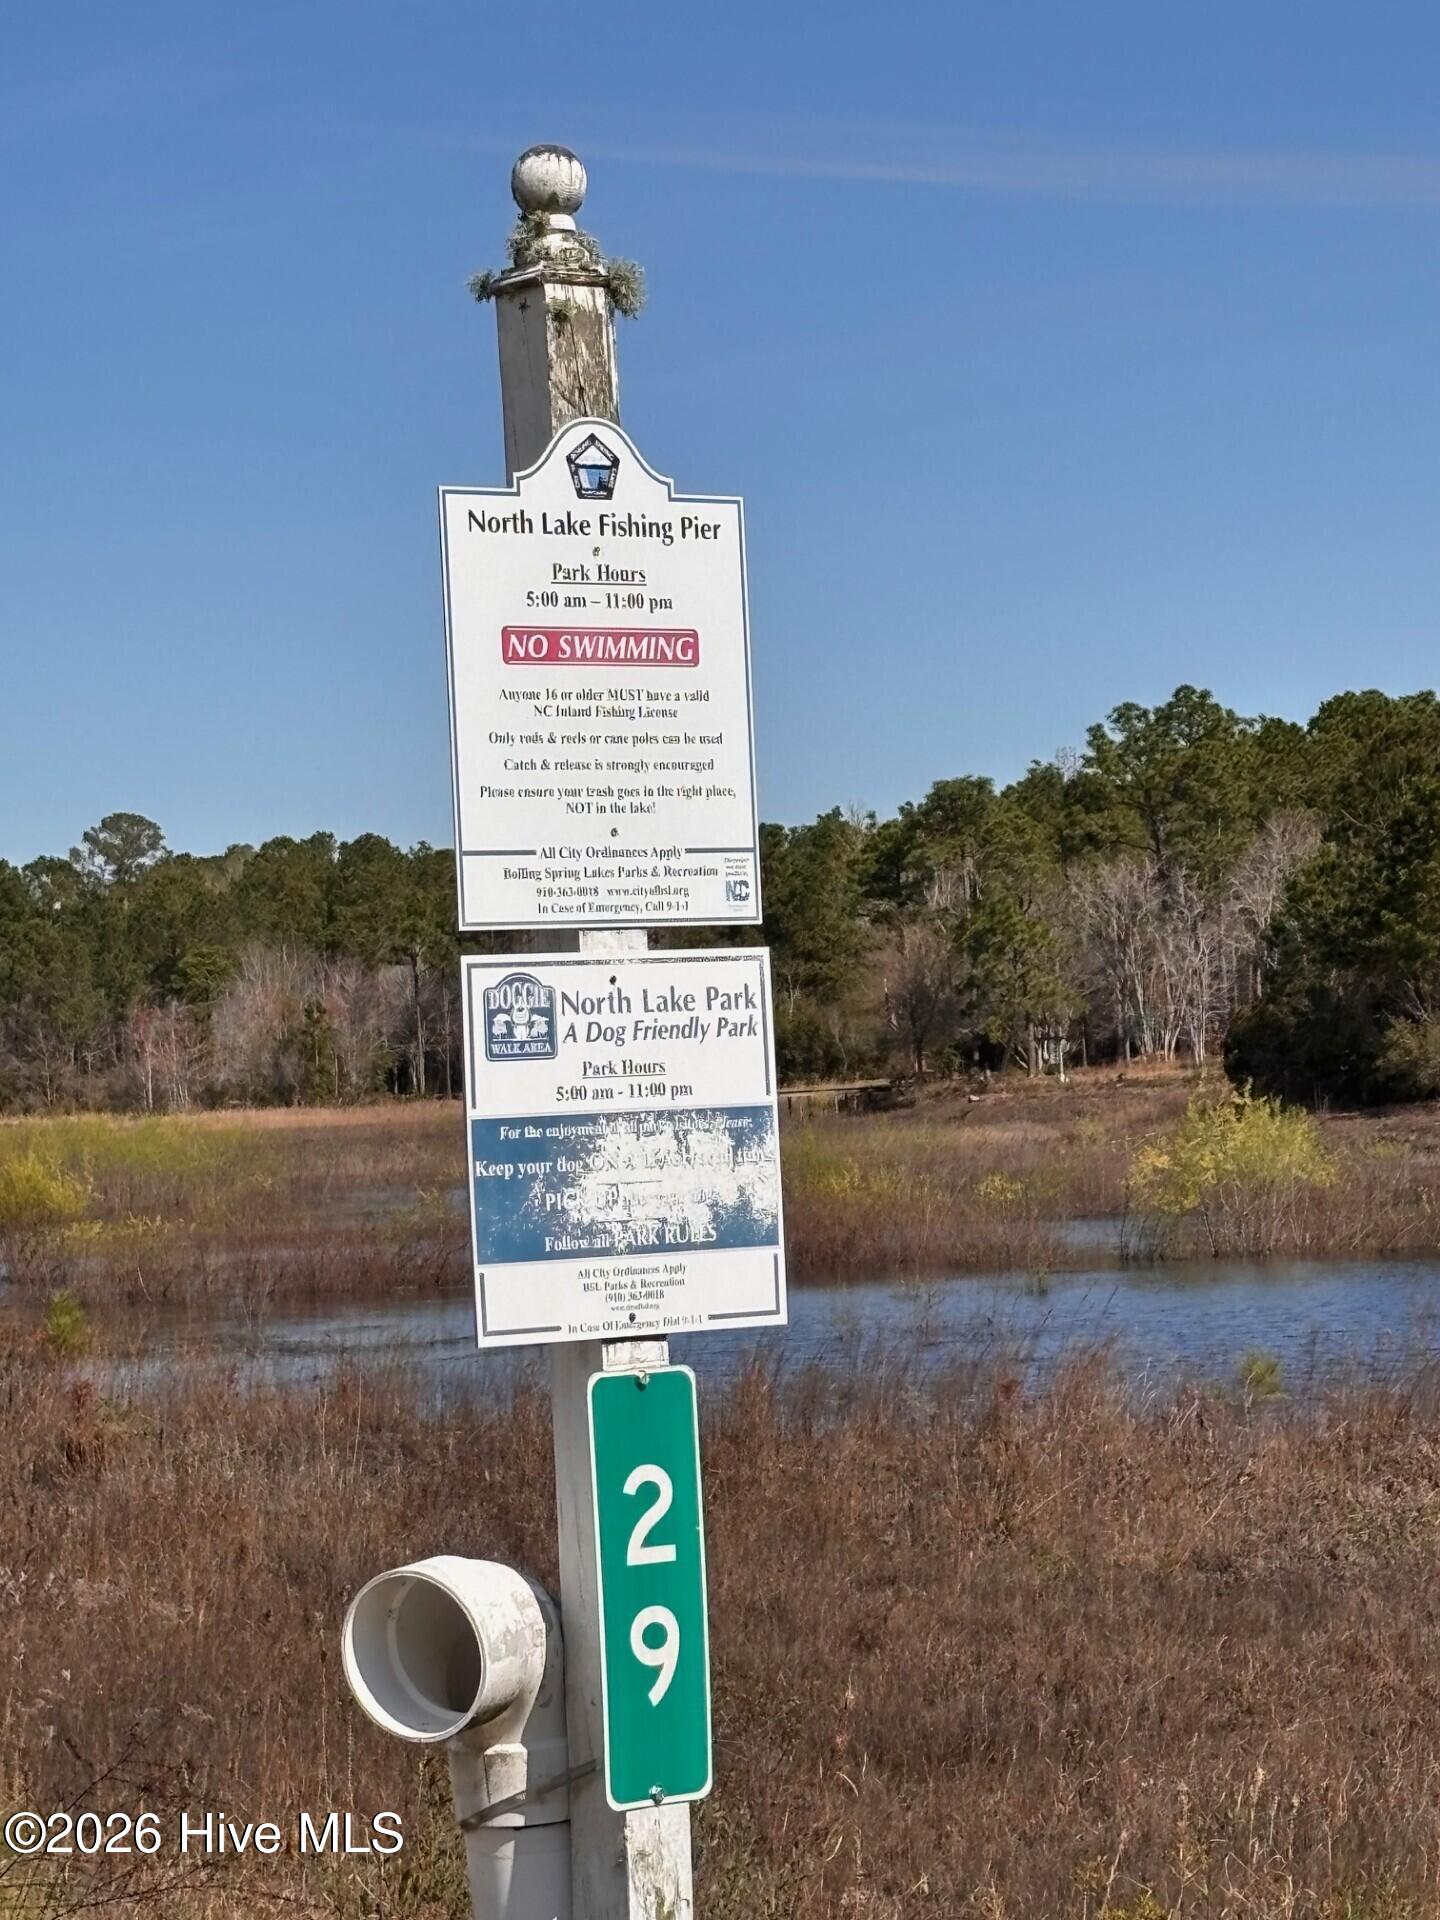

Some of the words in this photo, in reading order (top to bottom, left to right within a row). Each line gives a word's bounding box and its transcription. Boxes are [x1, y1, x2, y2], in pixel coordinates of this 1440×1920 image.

[468, 509, 534, 534] North
[542, 511, 591, 536] Lake
[600, 513, 674, 546] Fishing
[681, 517, 722, 540] Pier
[552, 563, 590, 582] Park
[598, 564, 646, 583] Hours
[526, 591, 558, 608] 5:00
[563, 596, 586, 608] am
[605, 592, 644, 610] 11:00
[650, 597, 672, 614] pm
[507, 634, 548, 658] NO
[558, 634, 694, 660] SWIMMING
[499, 688, 541, 702] Anyone
[546, 688, 558, 700] 16
[561, 692, 573, 700] or
[576, 688, 604, 701] older
[608, 688, 643, 701] MUST
[646, 690, 672, 702] have
[674, 692, 680, 702] a
[684, 690, 710, 702] valid
[534, 705, 552, 717] NC
[556, 705, 592, 717] Inland
[596, 705, 636, 720] Fishing
[638, 706, 678, 718] License
[489, 732, 515, 746] Only
[548, 732, 557, 744] &
[561, 732, 586, 744] reels
[590, 734, 602, 744] or
[604, 734, 629, 744] cane
[632, 732, 659, 748] poles
[662, 735, 680, 744] can
[684, 732, 696, 744] be
[699, 732, 723, 744] used
[504, 758, 537, 771] Catch
[540, 759, 551, 771] &
[554, 759, 592, 771] release
[594, 759, 603, 771] is
[606, 759, 650, 774] strongly
[654, 758, 714, 774] encouraged
[480, 786, 515, 798] Please
[518, 788, 554, 798] ensure
[558, 788, 582, 800] your
[586, 786, 614, 798] trash
[617, 788, 640, 800] goes
[656, 786, 674, 797] the
[677, 786, 702, 799] right
[706, 786, 736, 800] place,
[566, 802, 593, 814] NOT
[596, 802, 606, 814] in
[610, 802, 627, 814] the
[630, 802, 656, 814] lake!
[540, 847, 555, 859] All
[559, 846, 582, 861] City
[586, 846, 648, 858] Ordinances
[650, 846, 682, 860] Apply
[545, 867, 580, 882] Spring
[584, 866, 614, 878] Lakes
[618, 866, 648, 878] Parks
[650, 866, 660, 878] &
[664, 865, 718, 878] Recreation
[538, 903, 548, 914] In
[551, 903, 574, 914] Case
[576, 902, 586, 913] of
[588, 902, 642, 915] Emergency,
[646, 901, 664, 912] Call
[666, 901, 688, 912] 9-1-1
[488, 982, 550, 1010] DOGGIE
[561, 988, 632, 1016] North
[643, 987, 696, 1013] Lake
[706, 984, 758, 1011] Park
[563, 1021, 578, 1044] A
[586, 1020, 627, 1046] Dog
[632, 1016, 710, 1044] Friendly
[716, 1014, 758, 1038] Park
[491, 1043, 521, 1054] WALK
[523, 1042, 552, 1053] AREA
[582, 1060, 618, 1077] Park
[622, 1060, 666, 1076] Hours
[556, 1085, 587, 1101] 5:00
[592, 1088, 614, 1100] am
[628, 1083, 666, 1098] 11:00
[671, 1084, 693, 1100] pm
[500, 1126, 521, 1140] For
[524, 1125, 543, 1138] the
[475, 1160, 514, 1180] Keep
[518, 1160, 553, 1178] your
[557, 1156, 584, 1176] dog
[544, 1235, 590, 1251] Follow
[594, 1234, 610, 1248] all
[613, 1223, 660, 1247] PARK
[665, 1222, 718, 1245] RULES
[578, 1268, 590, 1279] All
[592, 1268, 610, 1280] City
[612, 1265, 660, 1277] Ordinances
[662, 1262, 688, 1275] Apply
[604, 1280, 628, 1292] Parks
[630, 1280, 638, 1290] &
[640, 1278, 685, 1289] Recreation
[568, 1324, 578, 1334] In
[580, 1322, 600, 1333] Case
[664, 1316, 680, 1327] Dial
